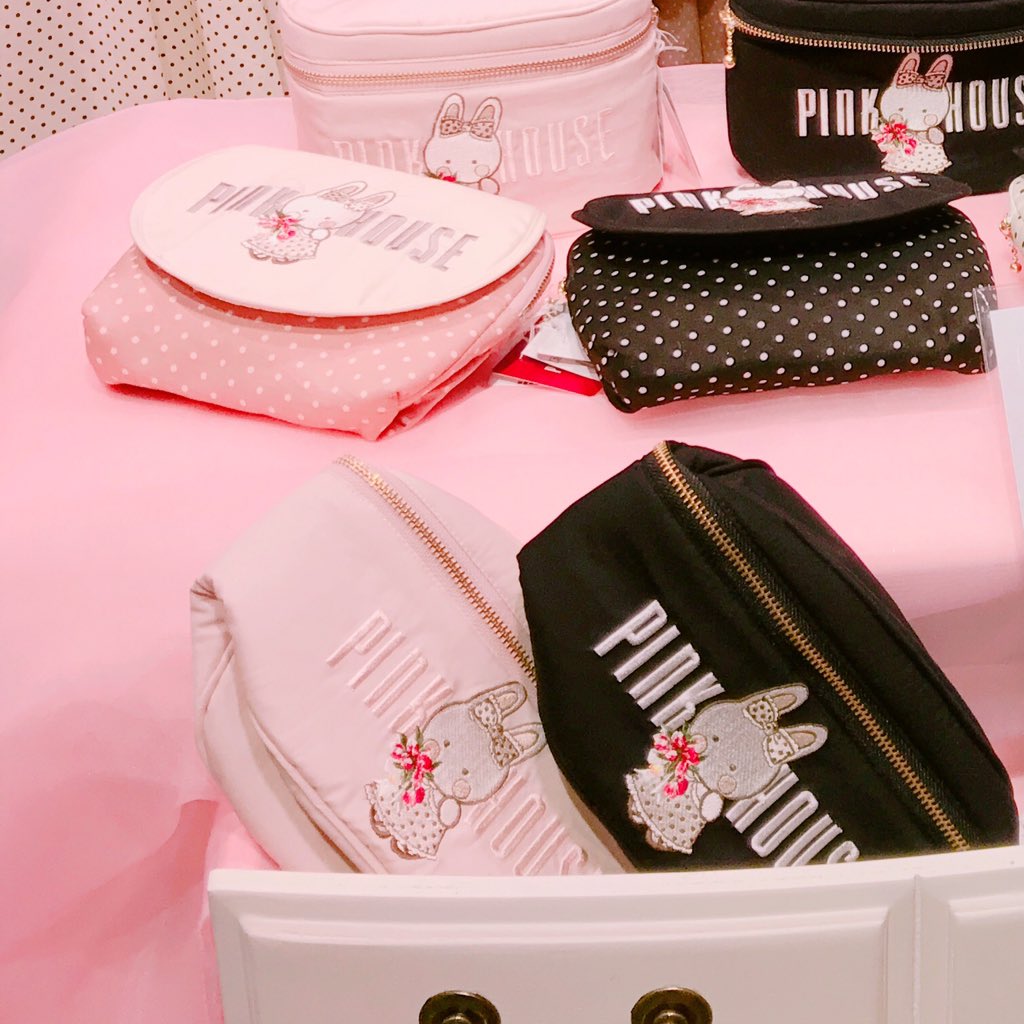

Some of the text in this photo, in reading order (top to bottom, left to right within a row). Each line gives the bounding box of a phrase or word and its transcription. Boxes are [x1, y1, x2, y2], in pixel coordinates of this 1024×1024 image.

[500, 108, 617, 184] HOUSE
[797, 88, 880, 137] PINK
[186, 182, 480, 272] PINK HOUSE
[627, 190, 731, 215] PINK
[326, 609, 589, 875] PINK HOU
[593, 599, 860, 866] PINK HOU
